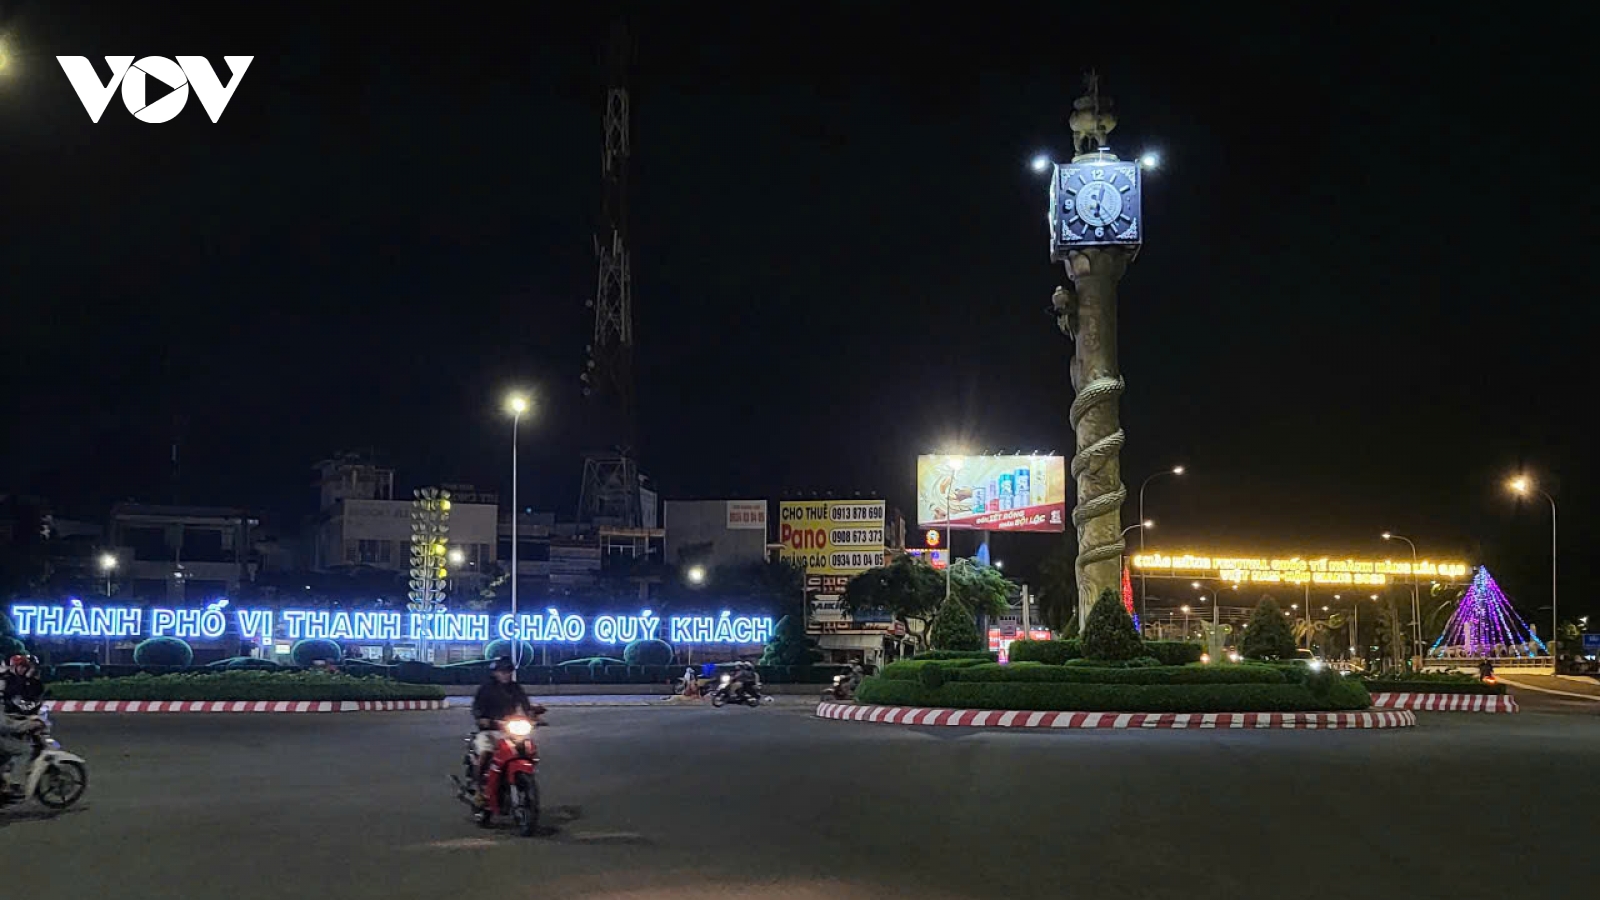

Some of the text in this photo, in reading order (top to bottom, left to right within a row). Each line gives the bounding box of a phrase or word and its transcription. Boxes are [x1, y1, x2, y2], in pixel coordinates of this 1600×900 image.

[1091, 169, 1104, 180] 12
[1064, 199, 1074, 209] 9
[1095, 227, 1104, 237] 6
[782, 503, 828, 520] CHO THUÊ
[832, 506, 883, 520] 0913 878 690
[781, 523, 827, 550] Pano
[868, 530, 883, 543] 373
[810, 552, 827, 568] CÁO
[832, 554, 851, 566] 0934
[852, 554, 862, 566] 03
[863, 554, 872, 566] 04
[1309, 558, 1328, 571] TẾ
[1219, 569, 1250, 582] VIỆT
[13, 598, 142, 636] THÀNH
[152, 598, 230, 637] PHỐ
[237, 609, 274, 646] VỊ
[283, 610, 401, 640] THANH
[409, 606, 490, 641] KÍNH
[498, 607, 586, 642] CHÀO
[594, 608, 661, 645] QUÝ
[671, 609, 774, 643] KHÁCH
